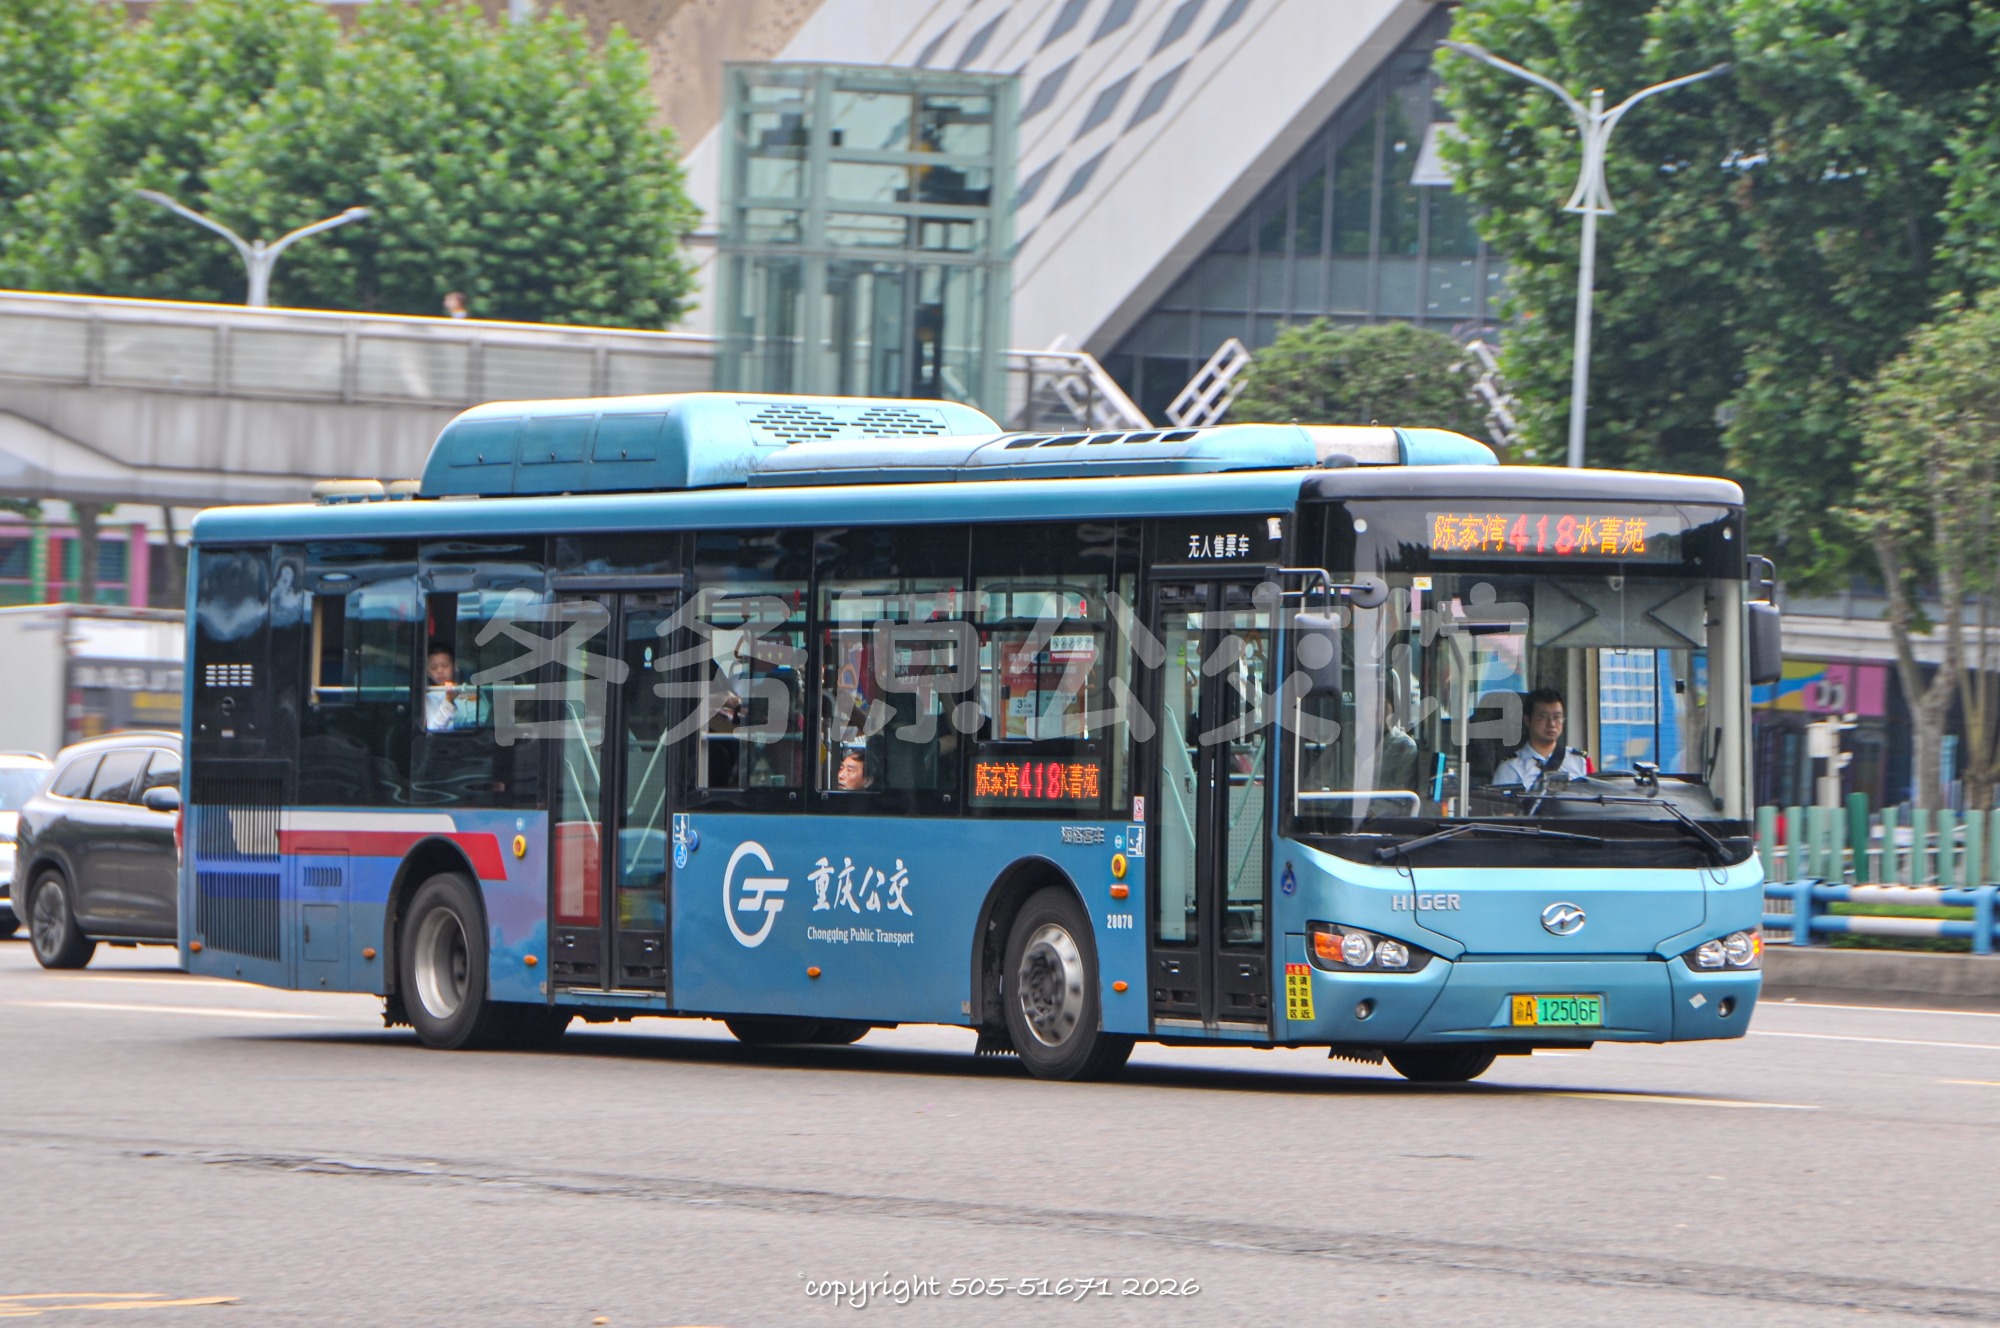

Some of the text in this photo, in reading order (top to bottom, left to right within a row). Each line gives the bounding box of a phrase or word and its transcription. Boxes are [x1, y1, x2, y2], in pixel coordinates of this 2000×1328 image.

[1188, 533, 1250, 558] 无人售票车
[807, 857, 913, 916] 重庆公交
[1392, 894, 1460, 911] HIGER
[1107, 914, 1133, 929] 28070
[807, 926, 914, 947] Chongqing Public Transport
